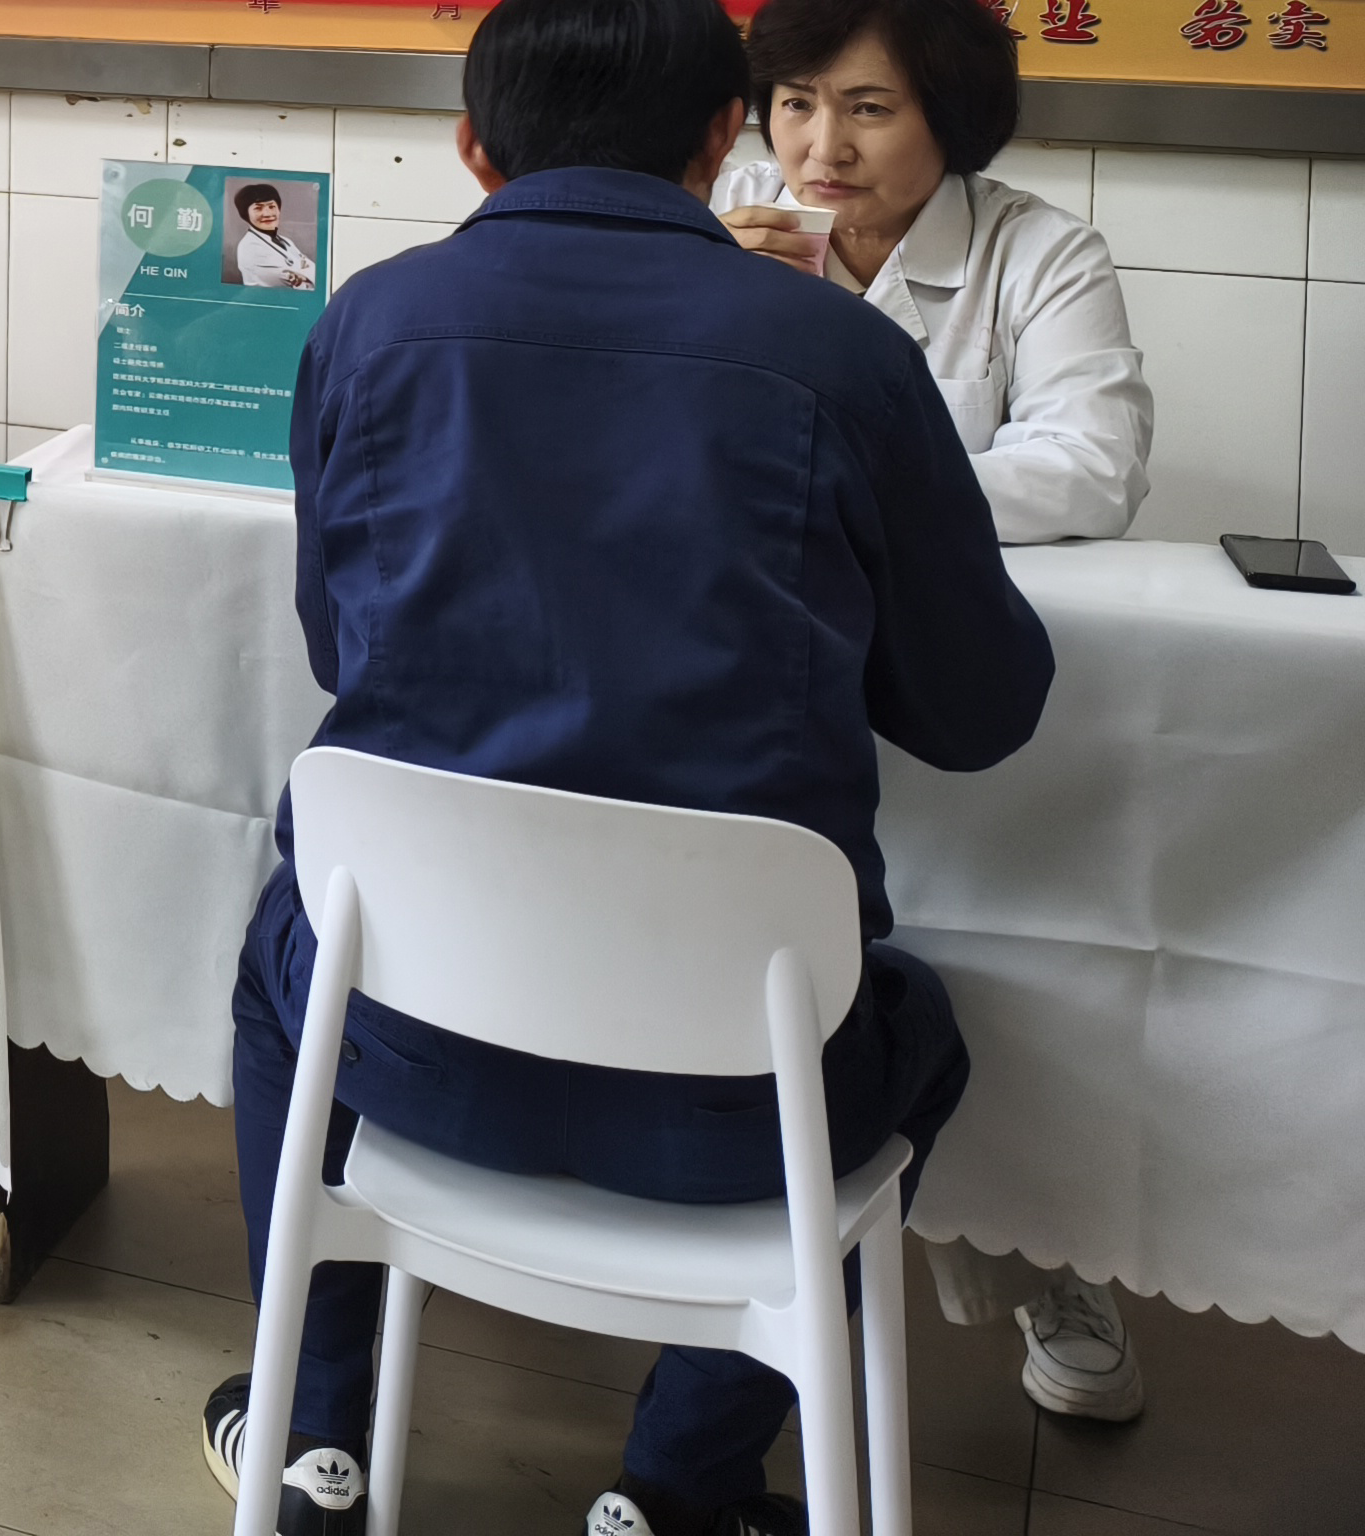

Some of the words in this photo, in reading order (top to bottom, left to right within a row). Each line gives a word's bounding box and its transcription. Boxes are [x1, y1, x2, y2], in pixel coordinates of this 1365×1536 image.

[140, 265, 160, 277] HE
[163, 266, 188, 279] QIN
[114, 303, 146, 319] 简介
[316, 1486, 350, 1497] adidas
